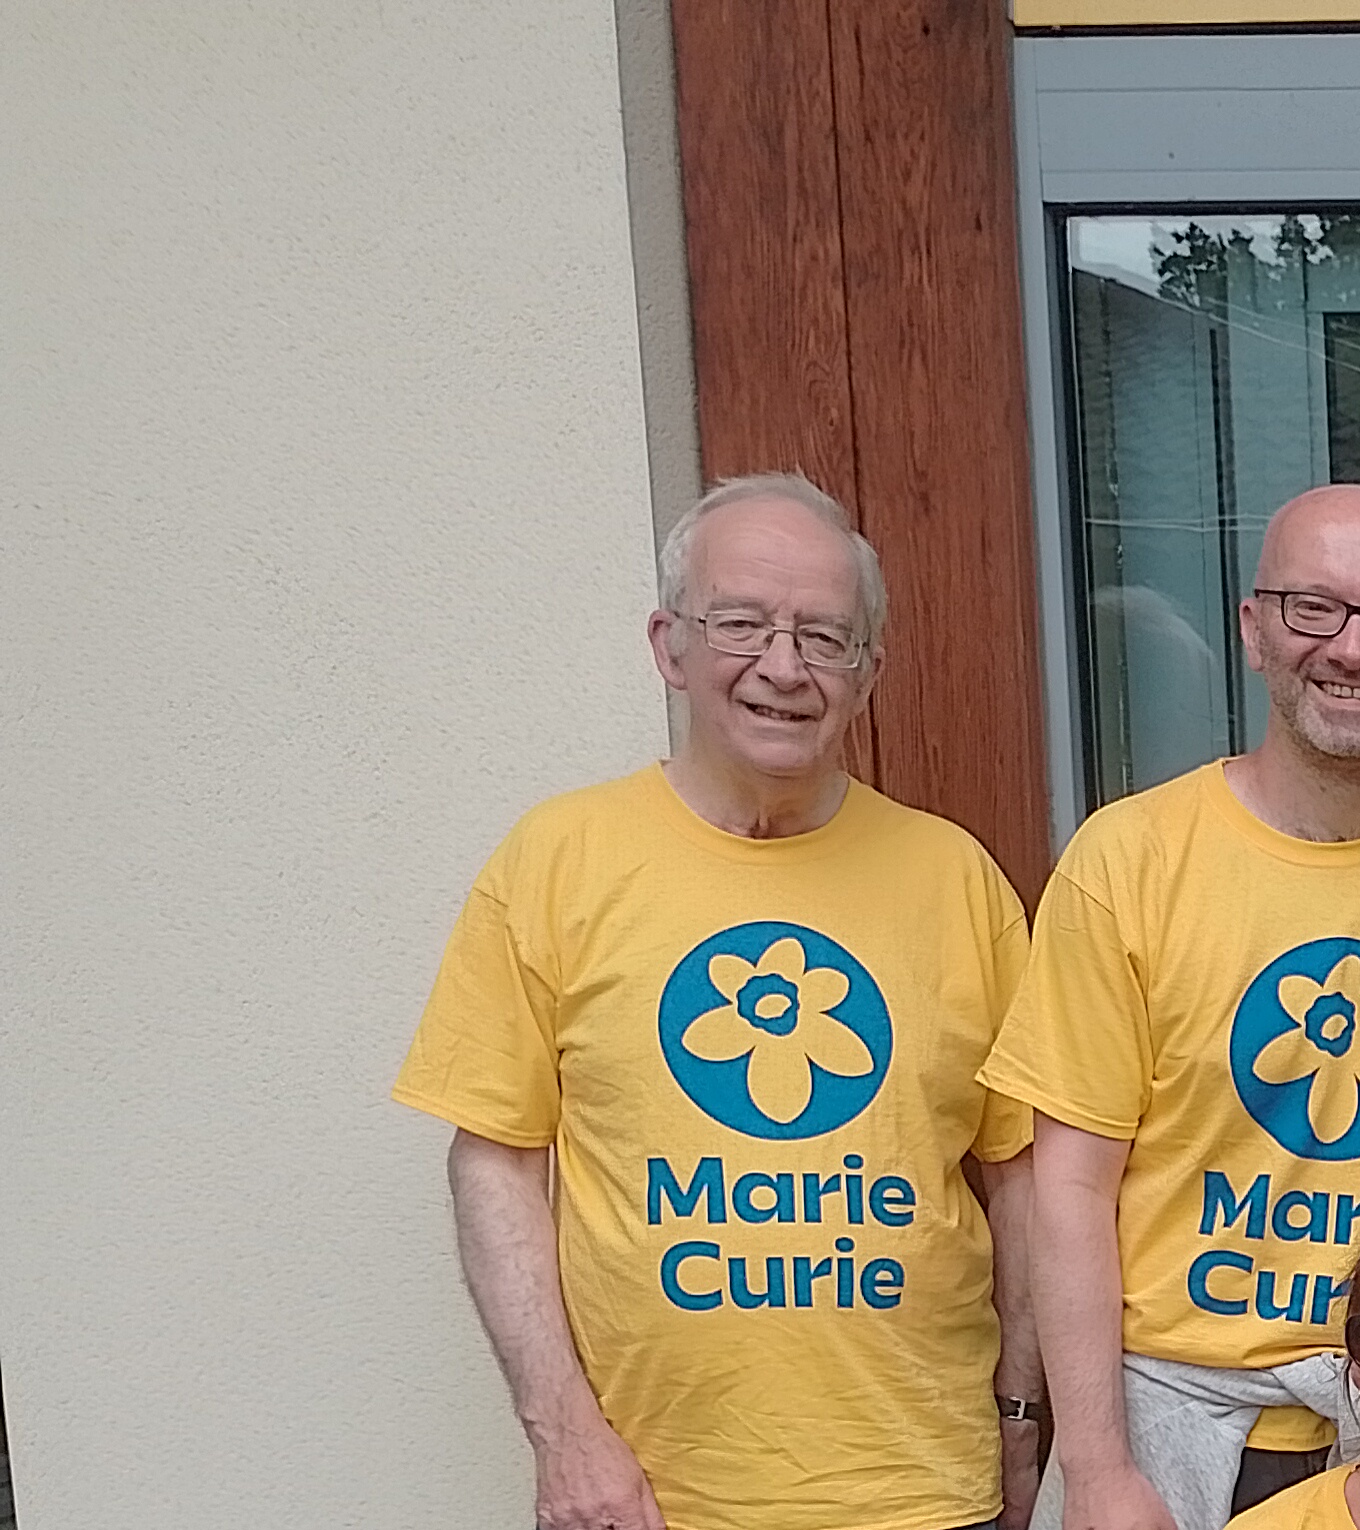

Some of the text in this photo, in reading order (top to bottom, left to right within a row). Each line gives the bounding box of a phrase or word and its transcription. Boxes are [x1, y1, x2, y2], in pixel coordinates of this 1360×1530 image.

[647, 1153, 917, 1228] Marie
[660, 1236, 905, 1311] Curie
[1187, 1249, 1351, 1325] Cur
